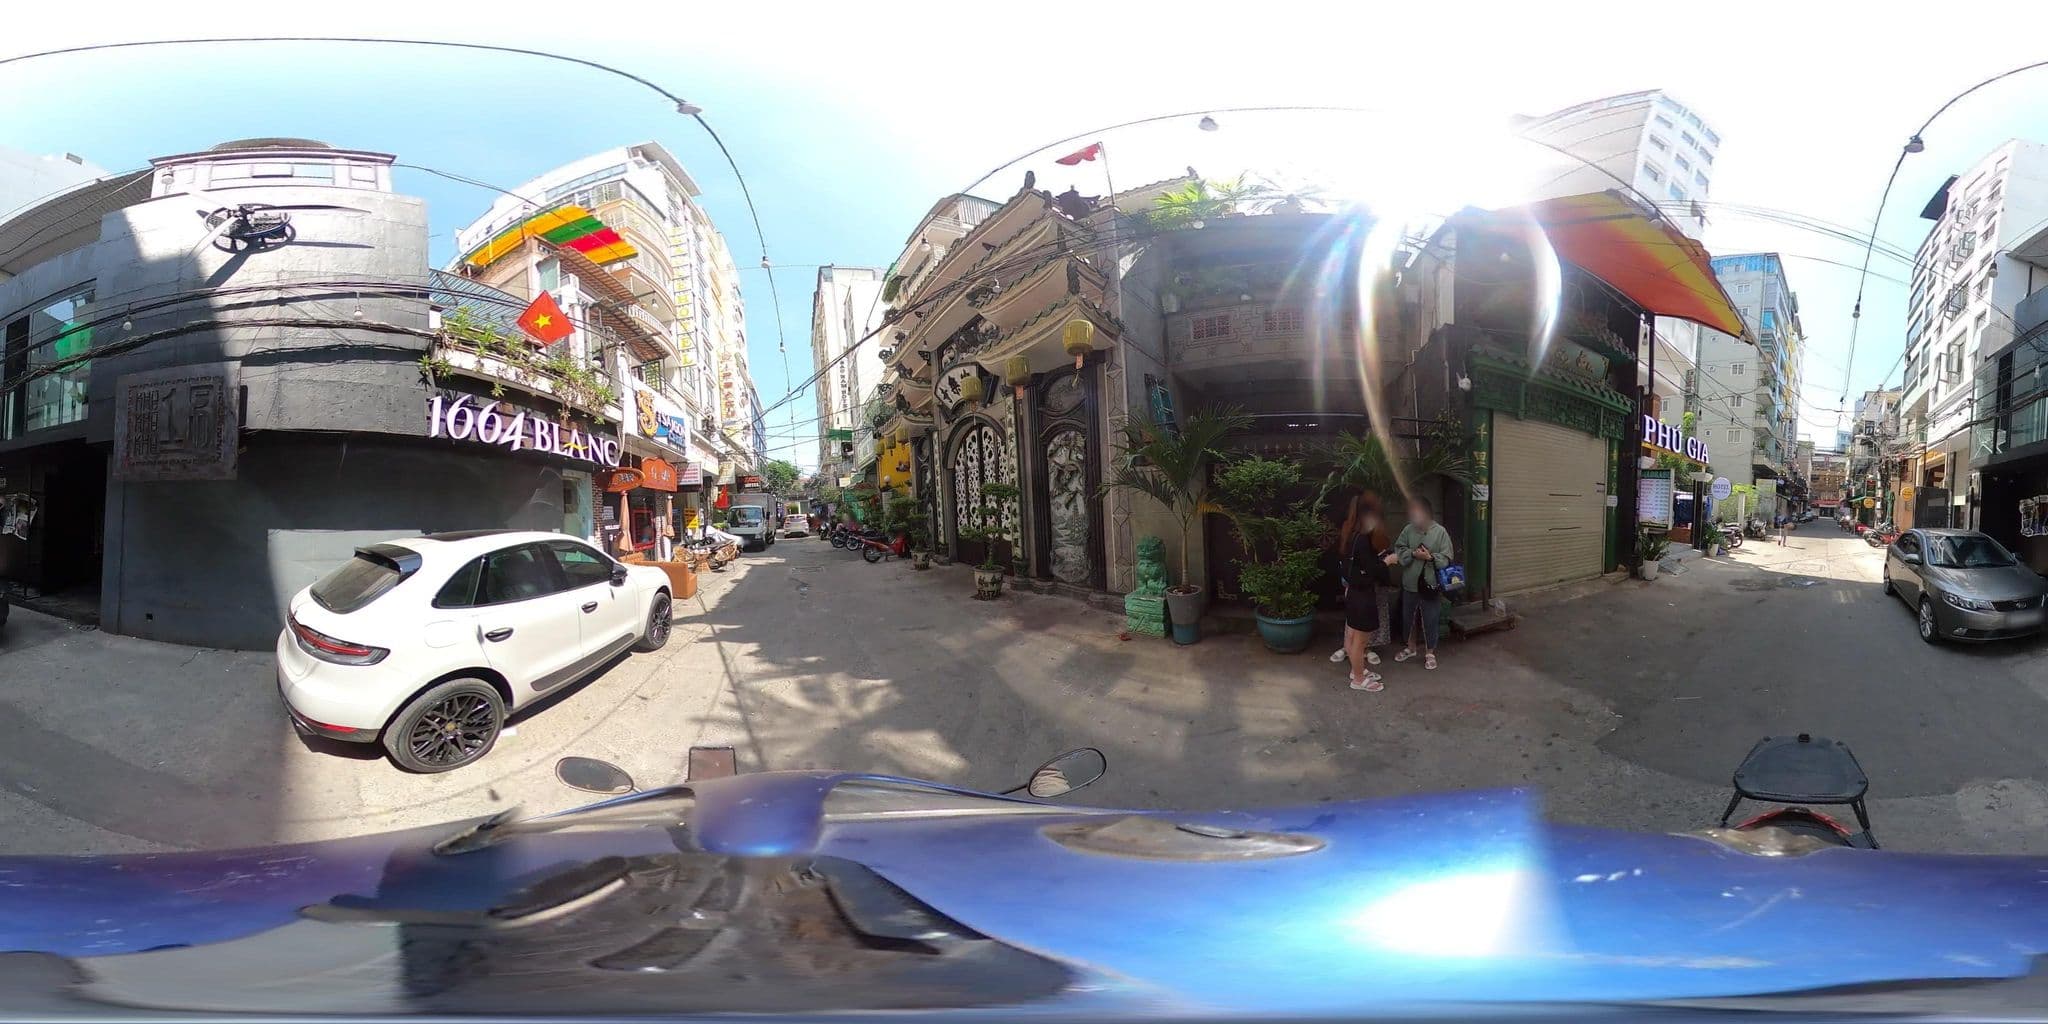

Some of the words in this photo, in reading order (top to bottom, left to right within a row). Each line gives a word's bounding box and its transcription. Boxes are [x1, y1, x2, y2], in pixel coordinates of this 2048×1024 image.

[430, 393, 528, 451] 1664
[533, 417, 620, 467] BLANC
[1643, 414, 1682, 454] PHÚ
[1686, 436, 1709, 464] GIA
